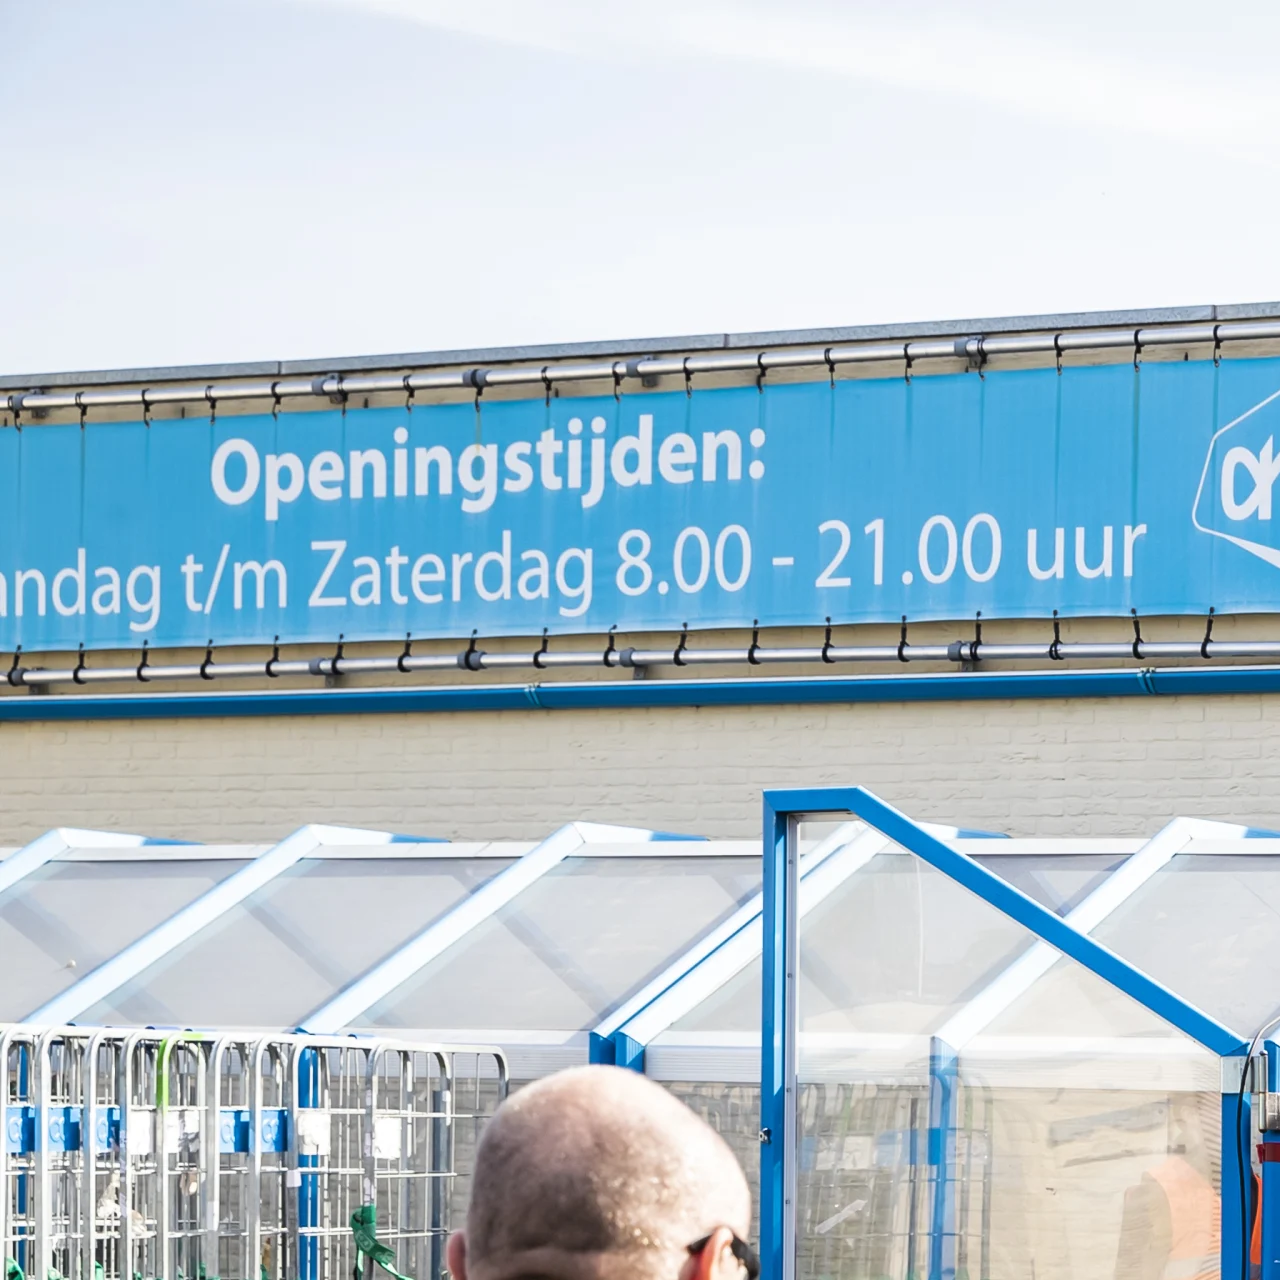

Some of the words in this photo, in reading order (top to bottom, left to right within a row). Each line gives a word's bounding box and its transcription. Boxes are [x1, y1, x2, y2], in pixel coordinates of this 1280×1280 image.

[211, 414, 766, 521] Openingstijden:
[181, 544, 288, 613] t/m
[309, 530, 594, 618] Zaterdag
[616, 524, 752, 597] 8.00
[816, 512, 1001, 589] 21.00
[1027, 523, 1148, 580] uur
